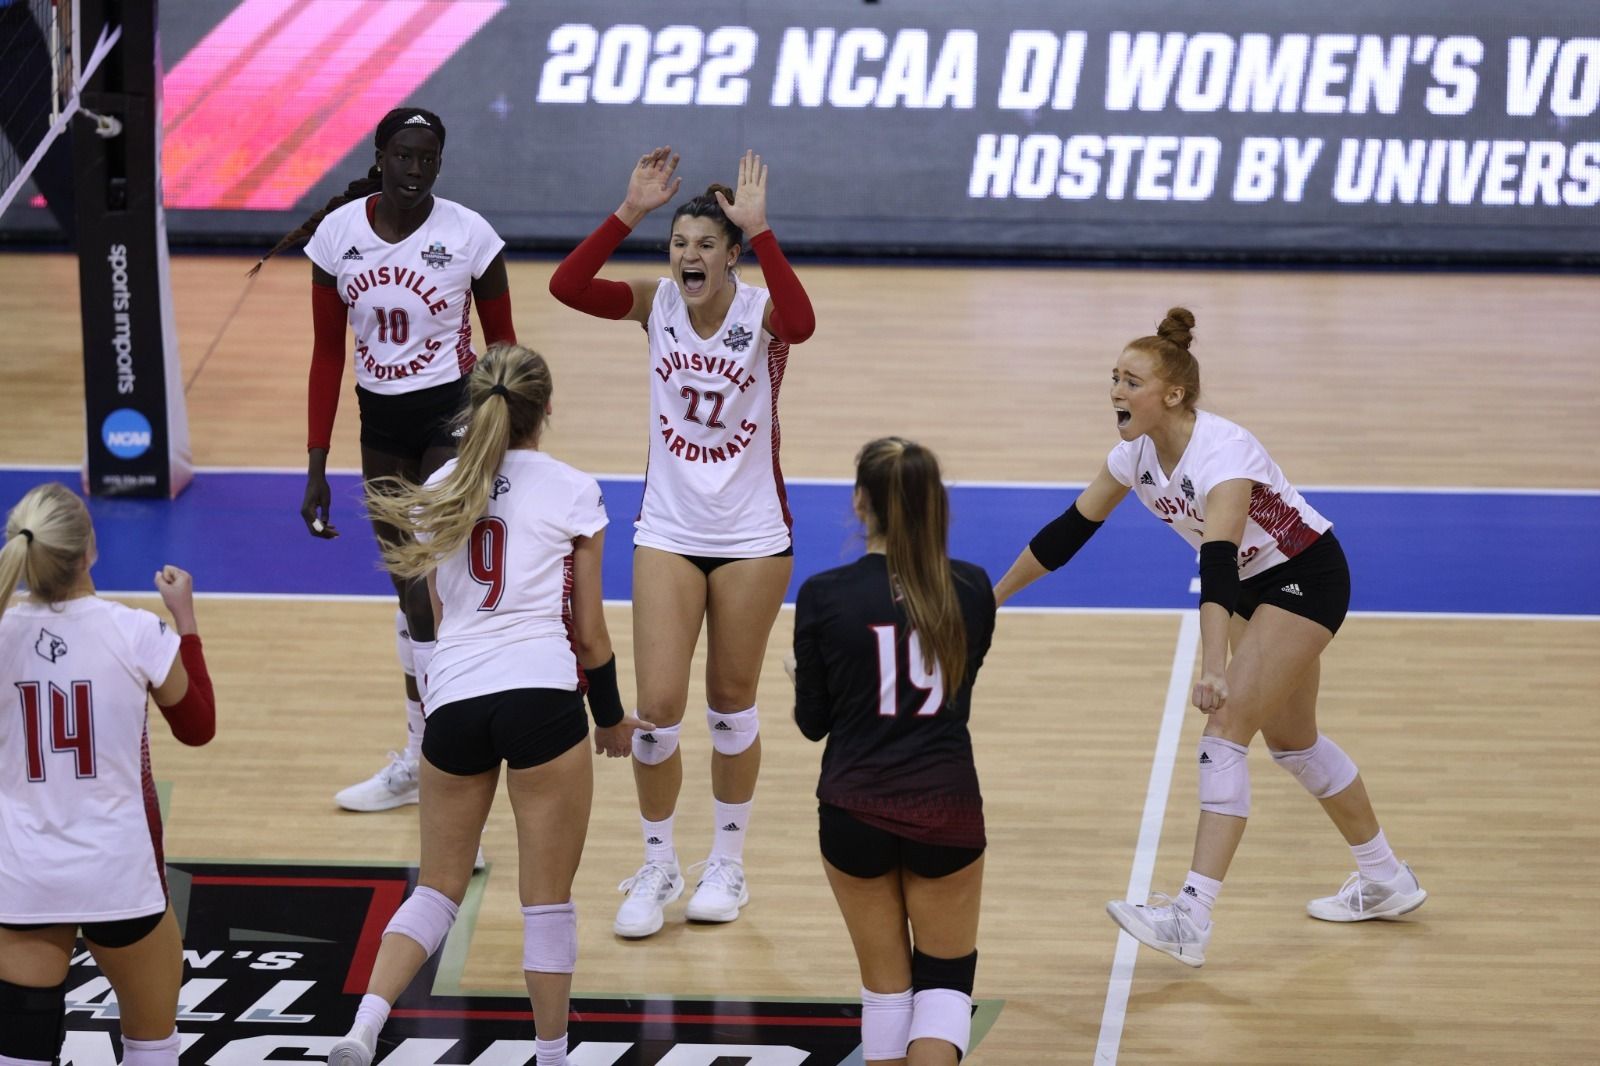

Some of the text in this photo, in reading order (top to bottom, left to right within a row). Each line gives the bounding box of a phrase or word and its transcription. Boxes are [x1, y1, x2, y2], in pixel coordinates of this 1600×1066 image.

[537, 23, 758, 105] 2022
[771, 27, 978, 109] NCAA
[998, 30, 1088, 110] DI
[1104, 31, 1484, 115] WOMEN'S
[968, 133, 1600, 206] HOSTED BY UNIVERS
[108, 244, 136, 395] sports imports
[359, 338, 442, 380] ARDINALS
[373, 306, 410, 346] 10
[108, 431, 151, 448] NCAA
[680, 385, 726, 430] 22
[467, 515, 508, 612] 9
[867, 623, 944, 716] 19
[14, 680, 97, 783] 14
